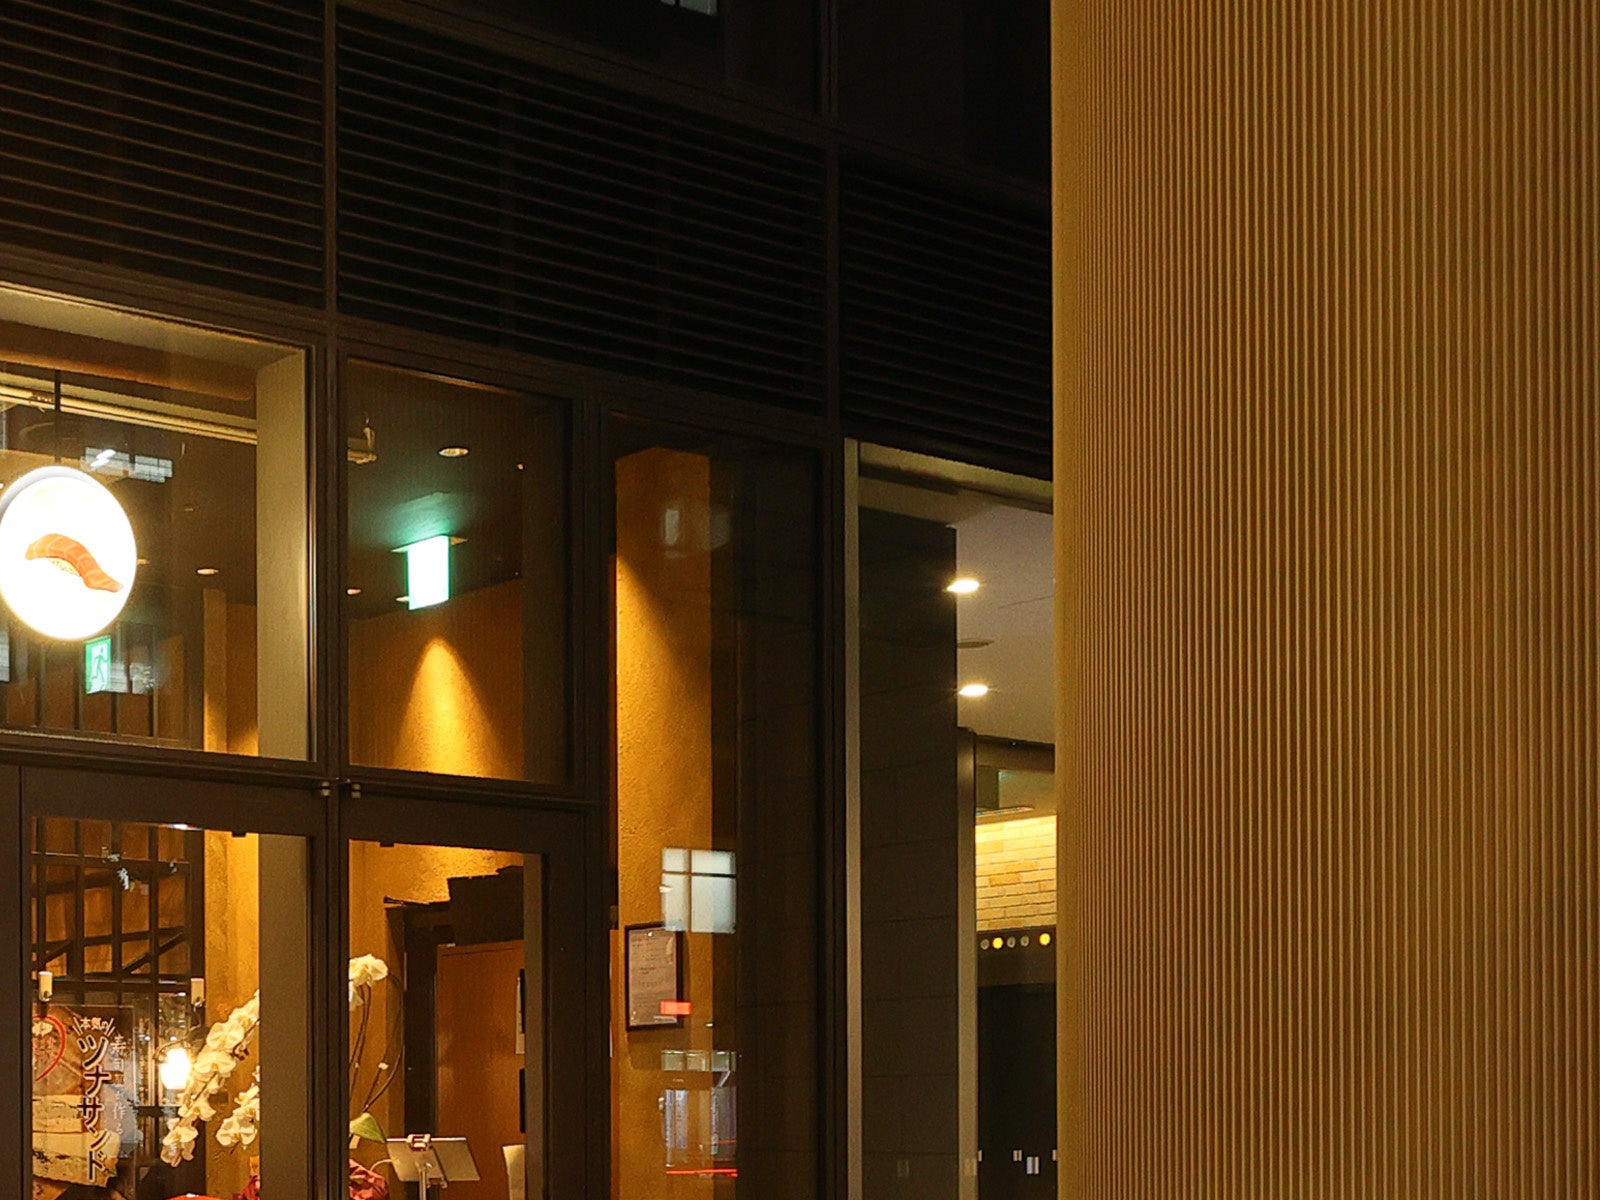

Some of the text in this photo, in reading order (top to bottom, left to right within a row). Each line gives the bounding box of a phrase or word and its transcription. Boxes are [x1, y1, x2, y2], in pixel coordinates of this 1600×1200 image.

[80, 1016, 109, 1031] 本気の
[77, 1035, 112, 1183] ツナサンド
